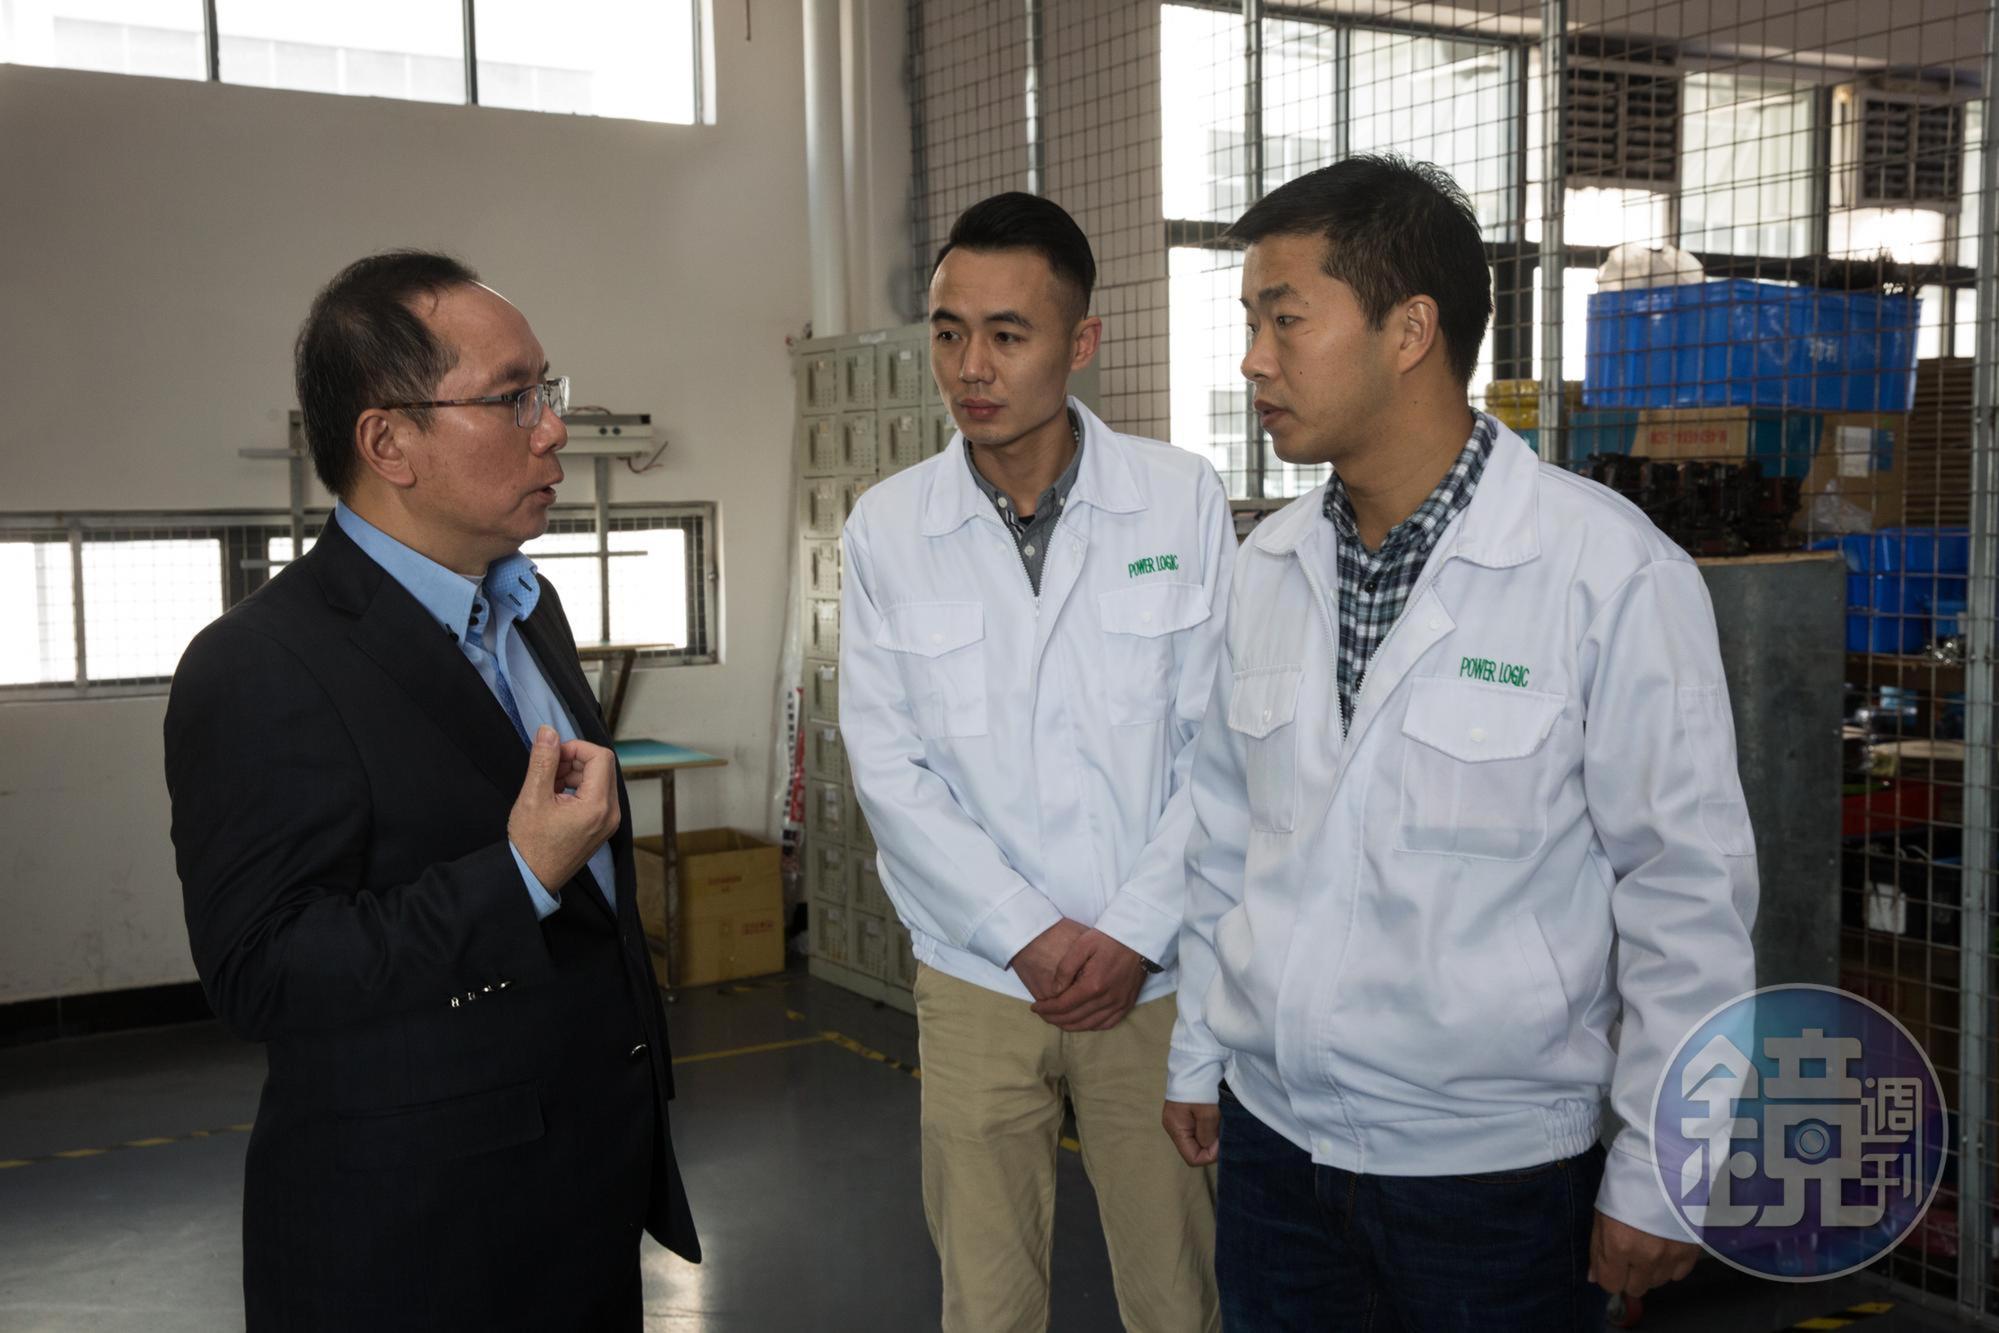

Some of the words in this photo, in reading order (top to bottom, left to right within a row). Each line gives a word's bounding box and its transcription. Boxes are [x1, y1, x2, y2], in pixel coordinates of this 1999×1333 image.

[1128, 557, 1156, 578] POWER
[1156, 554, 1179, 572] LOGIC
[1460, 656, 1497, 682] POWER
[1498, 661, 1530, 687] LOGIC
